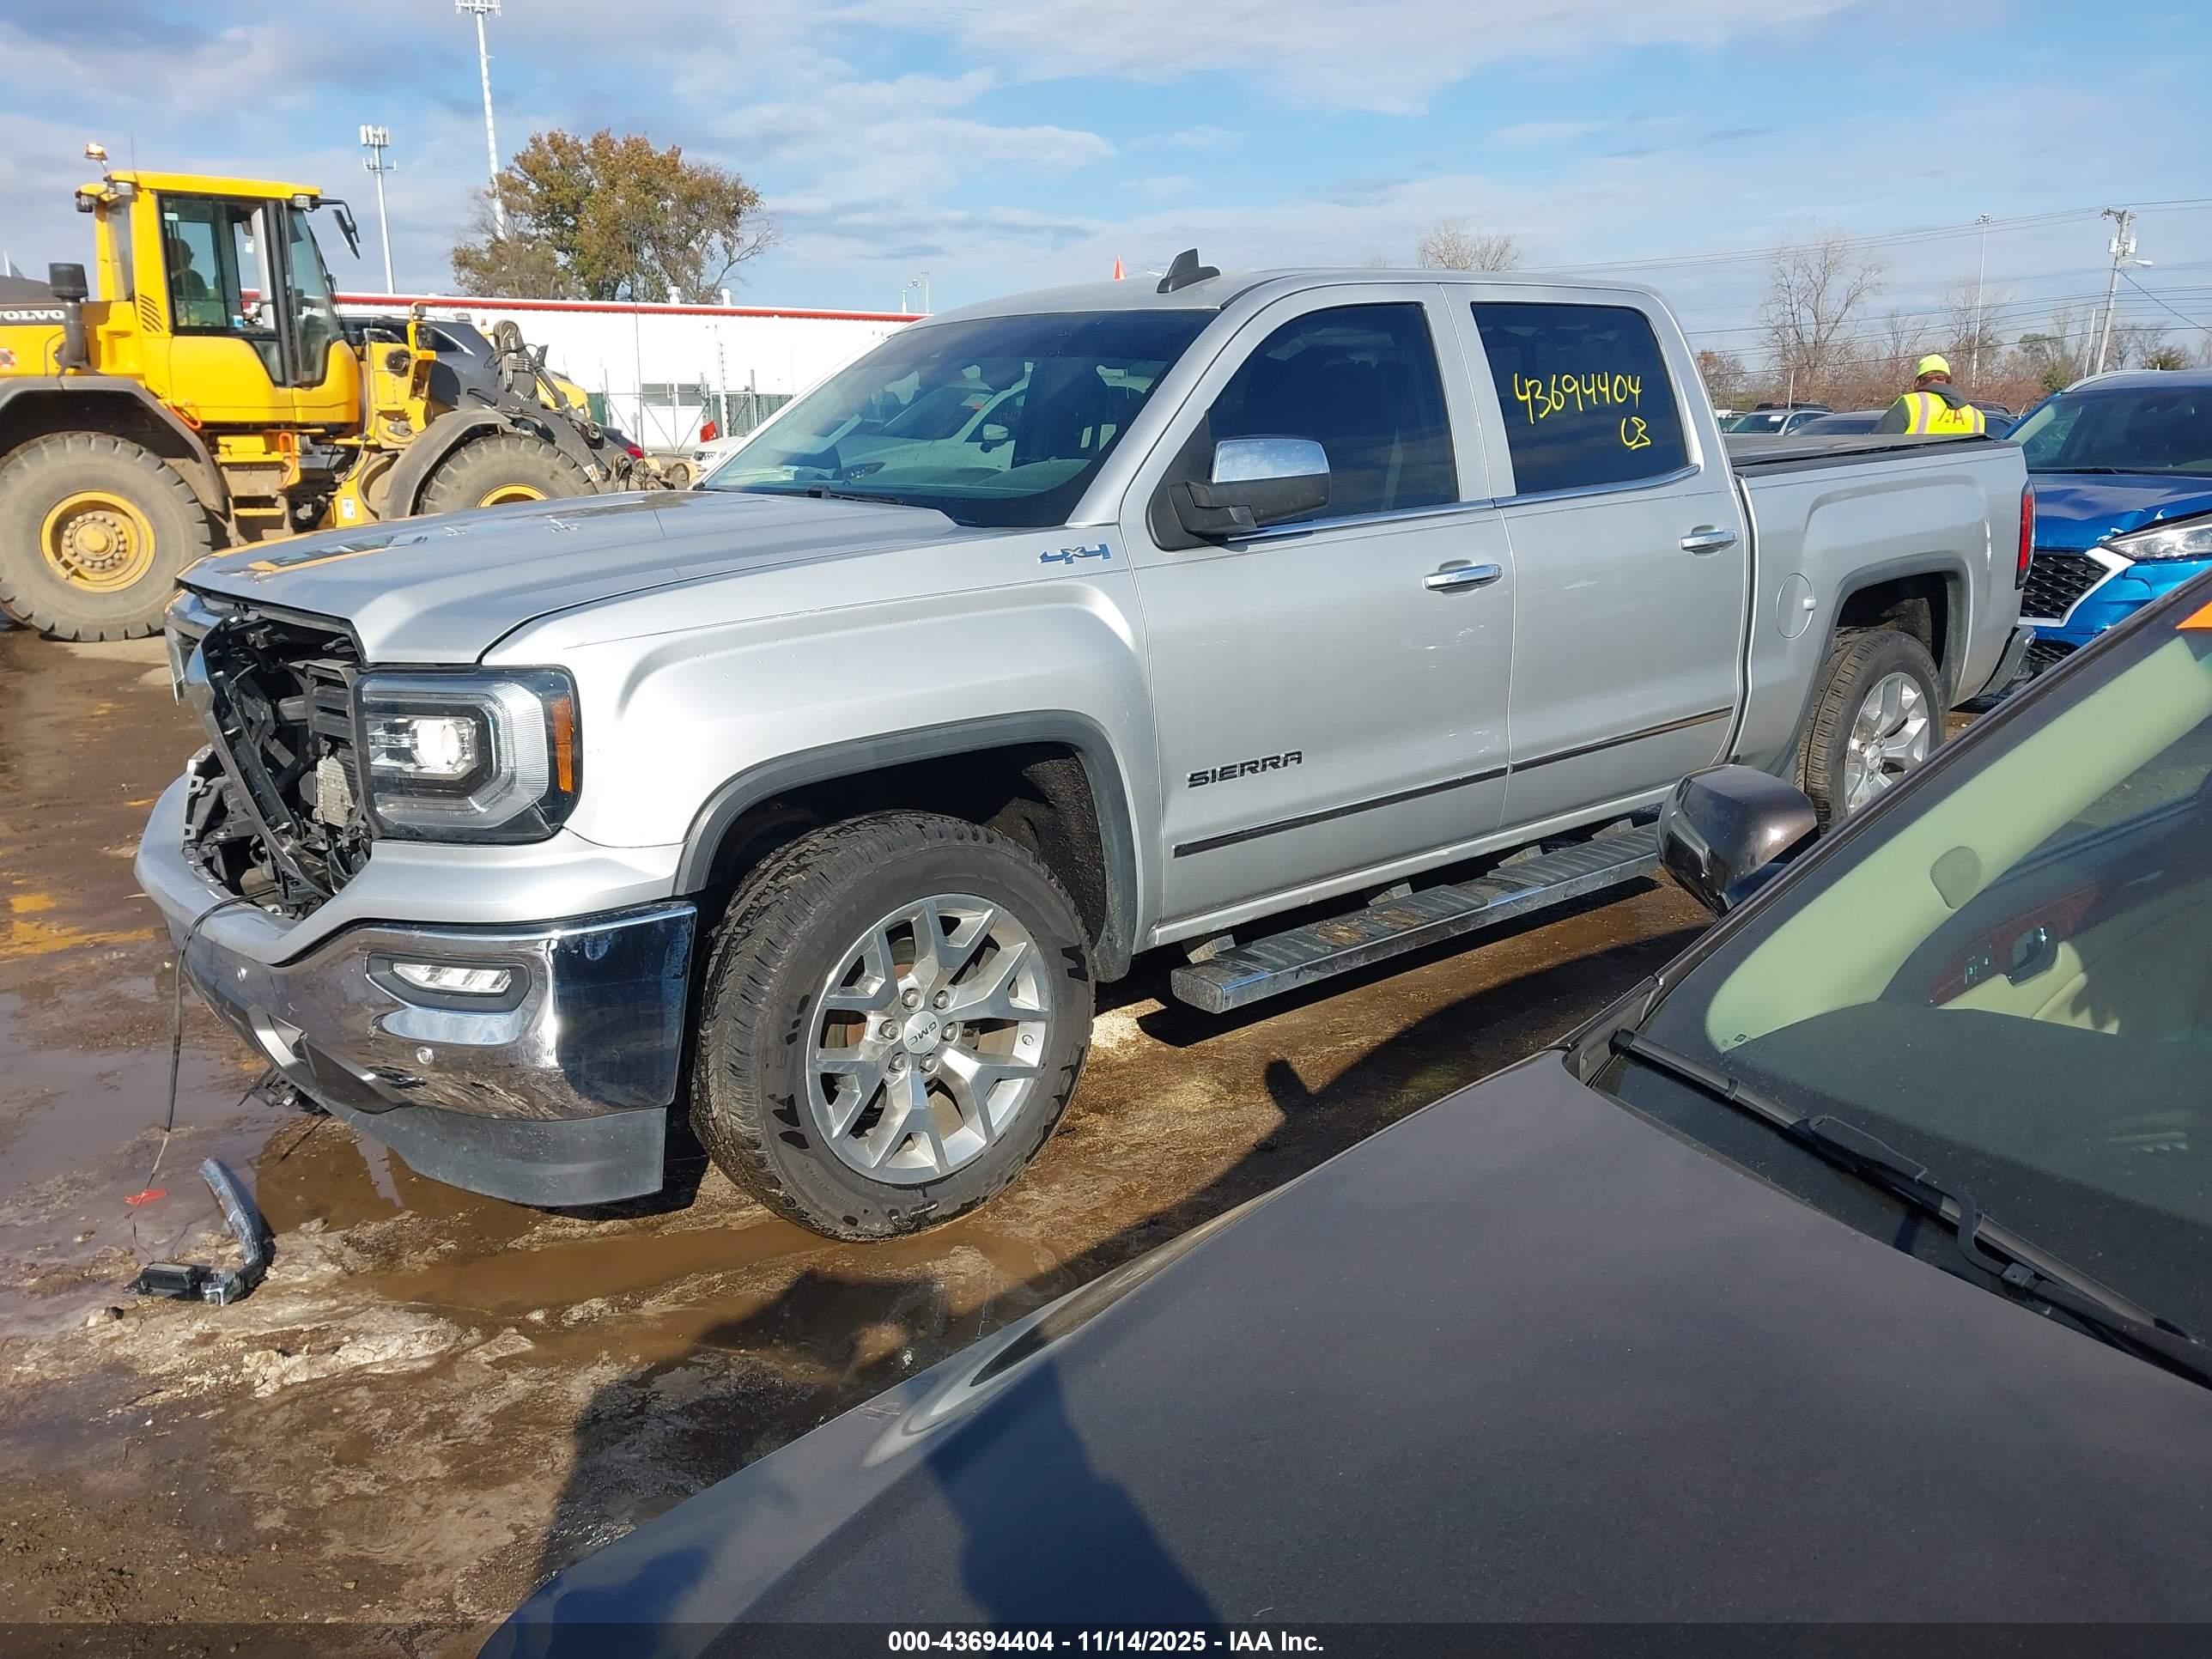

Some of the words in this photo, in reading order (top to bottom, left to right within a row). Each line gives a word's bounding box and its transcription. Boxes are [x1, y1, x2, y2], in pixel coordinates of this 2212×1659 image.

[0, 310, 65, 320] OLVO
[1513, 371, 1643, 425] 43694404
[1186, 749, 1304, 788] SIERRA
[908, 1021, 938, 1046] GMC
